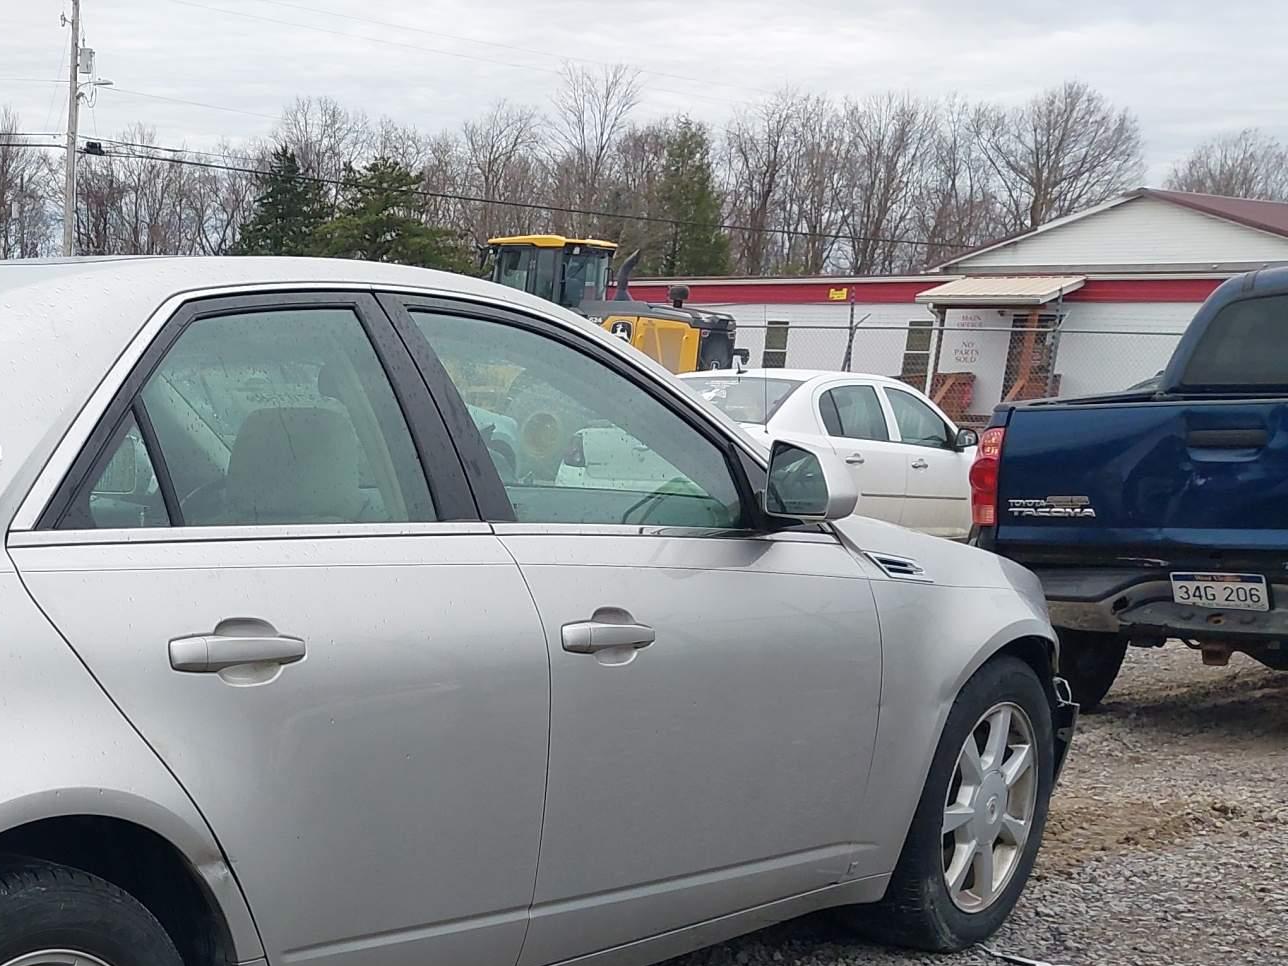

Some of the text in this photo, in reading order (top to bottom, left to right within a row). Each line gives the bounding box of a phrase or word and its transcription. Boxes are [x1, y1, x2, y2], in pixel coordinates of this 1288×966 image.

[961, 313, 982, 321] MAIN
[954, 348, 979, 356] PARTS
[1008, 499, 1046, 507] TOYOTA
[1008, 507, 1096, 517] TACOMA
[1178, 585, 1261, 603] 34G 206
